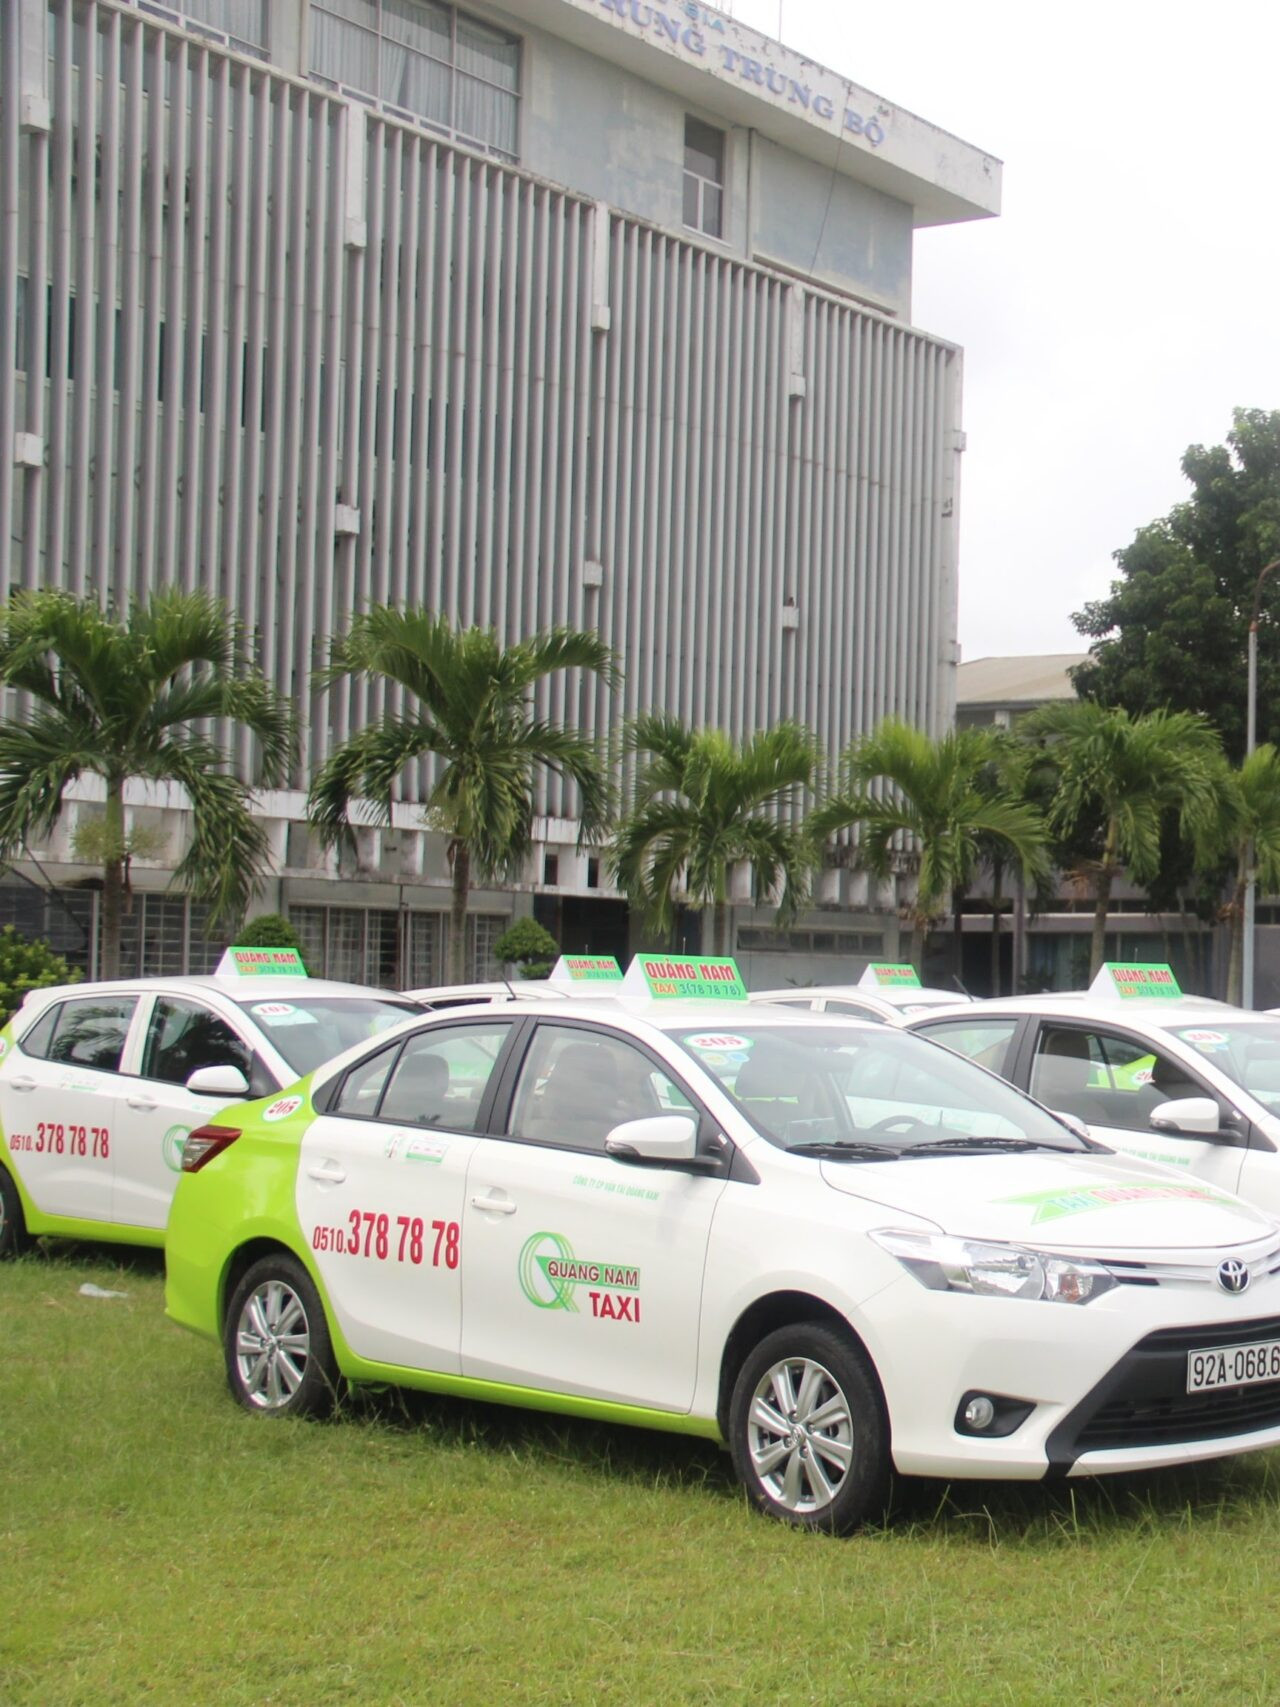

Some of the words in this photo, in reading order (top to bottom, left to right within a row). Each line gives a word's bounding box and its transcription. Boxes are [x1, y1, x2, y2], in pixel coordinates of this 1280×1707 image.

[720, 44, 834, 121] TRUNG
[843, 108, 885, 147] BỘ
[645, 958, 697, 980] QUẢNG
[699, 964, 736, 981] NAM
[653, 982, 678, 993] TAXI
[36, 1122, 64, 1154] 378
[69, 1125, 86, 1156] 78
[91, 1127, 109, 1159] 78
[397, 1216, 423, 1264] 78
[432, 1220, 460, 1270] 78
[548, 1260, 600, 1282] QUANG
[604, 1267, 638, 1286] NAM
[589, 1292, 640, 1323] TAXI
